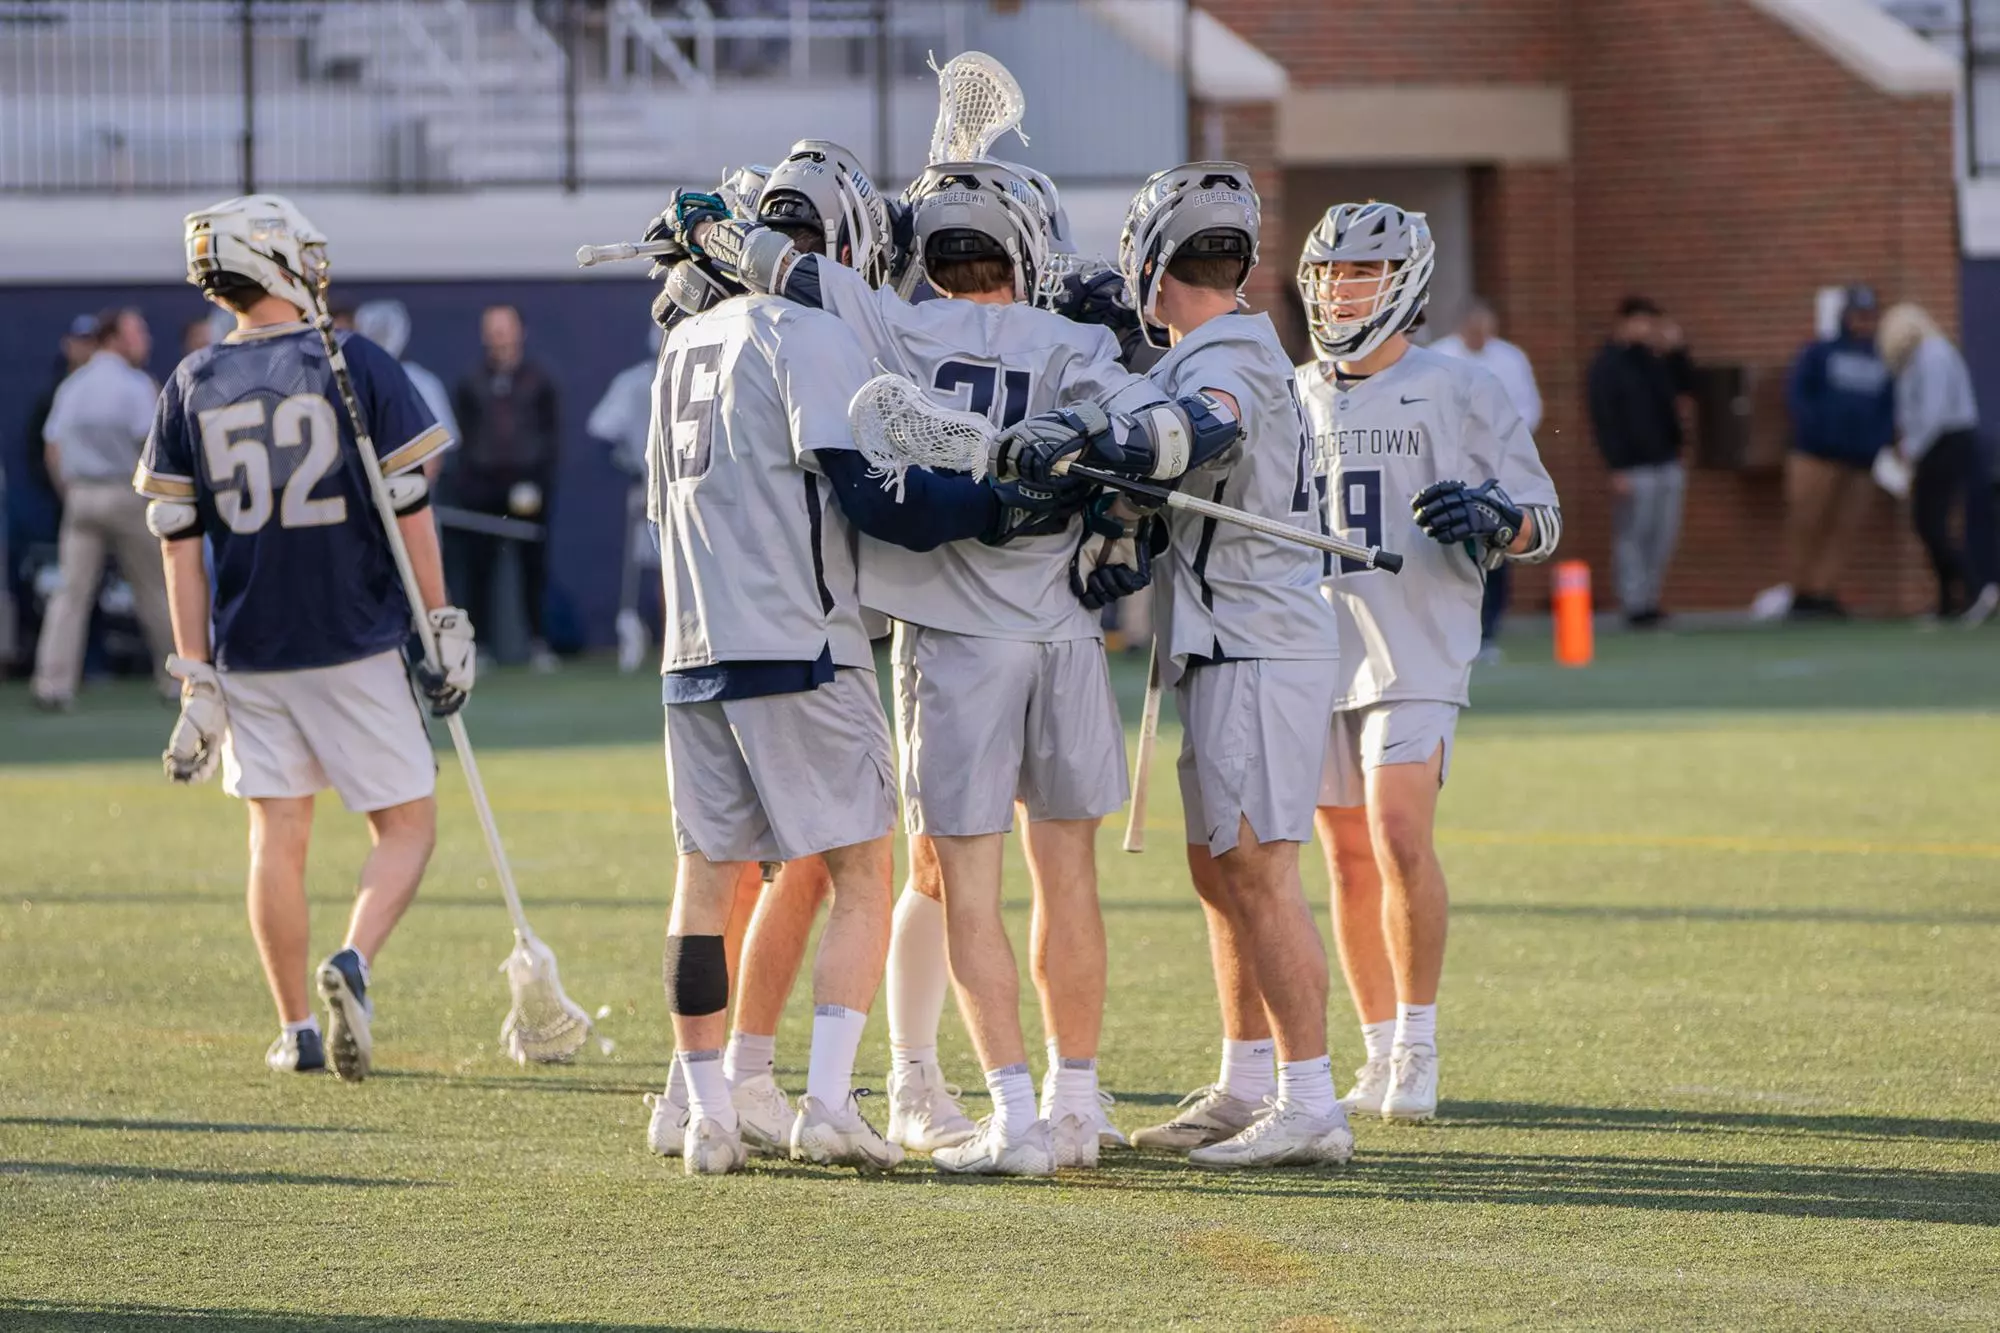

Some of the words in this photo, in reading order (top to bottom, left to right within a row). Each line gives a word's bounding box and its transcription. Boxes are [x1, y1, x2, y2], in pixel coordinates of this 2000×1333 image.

[928, 190, 986, 208] GEORGETOWN
[1193, 190, 1248, 207] GEORGETOWN
[197, 392, 349, 534] 52
[659, 342, 723, 483] 15
[1314, 468, 1383, 578] 19
